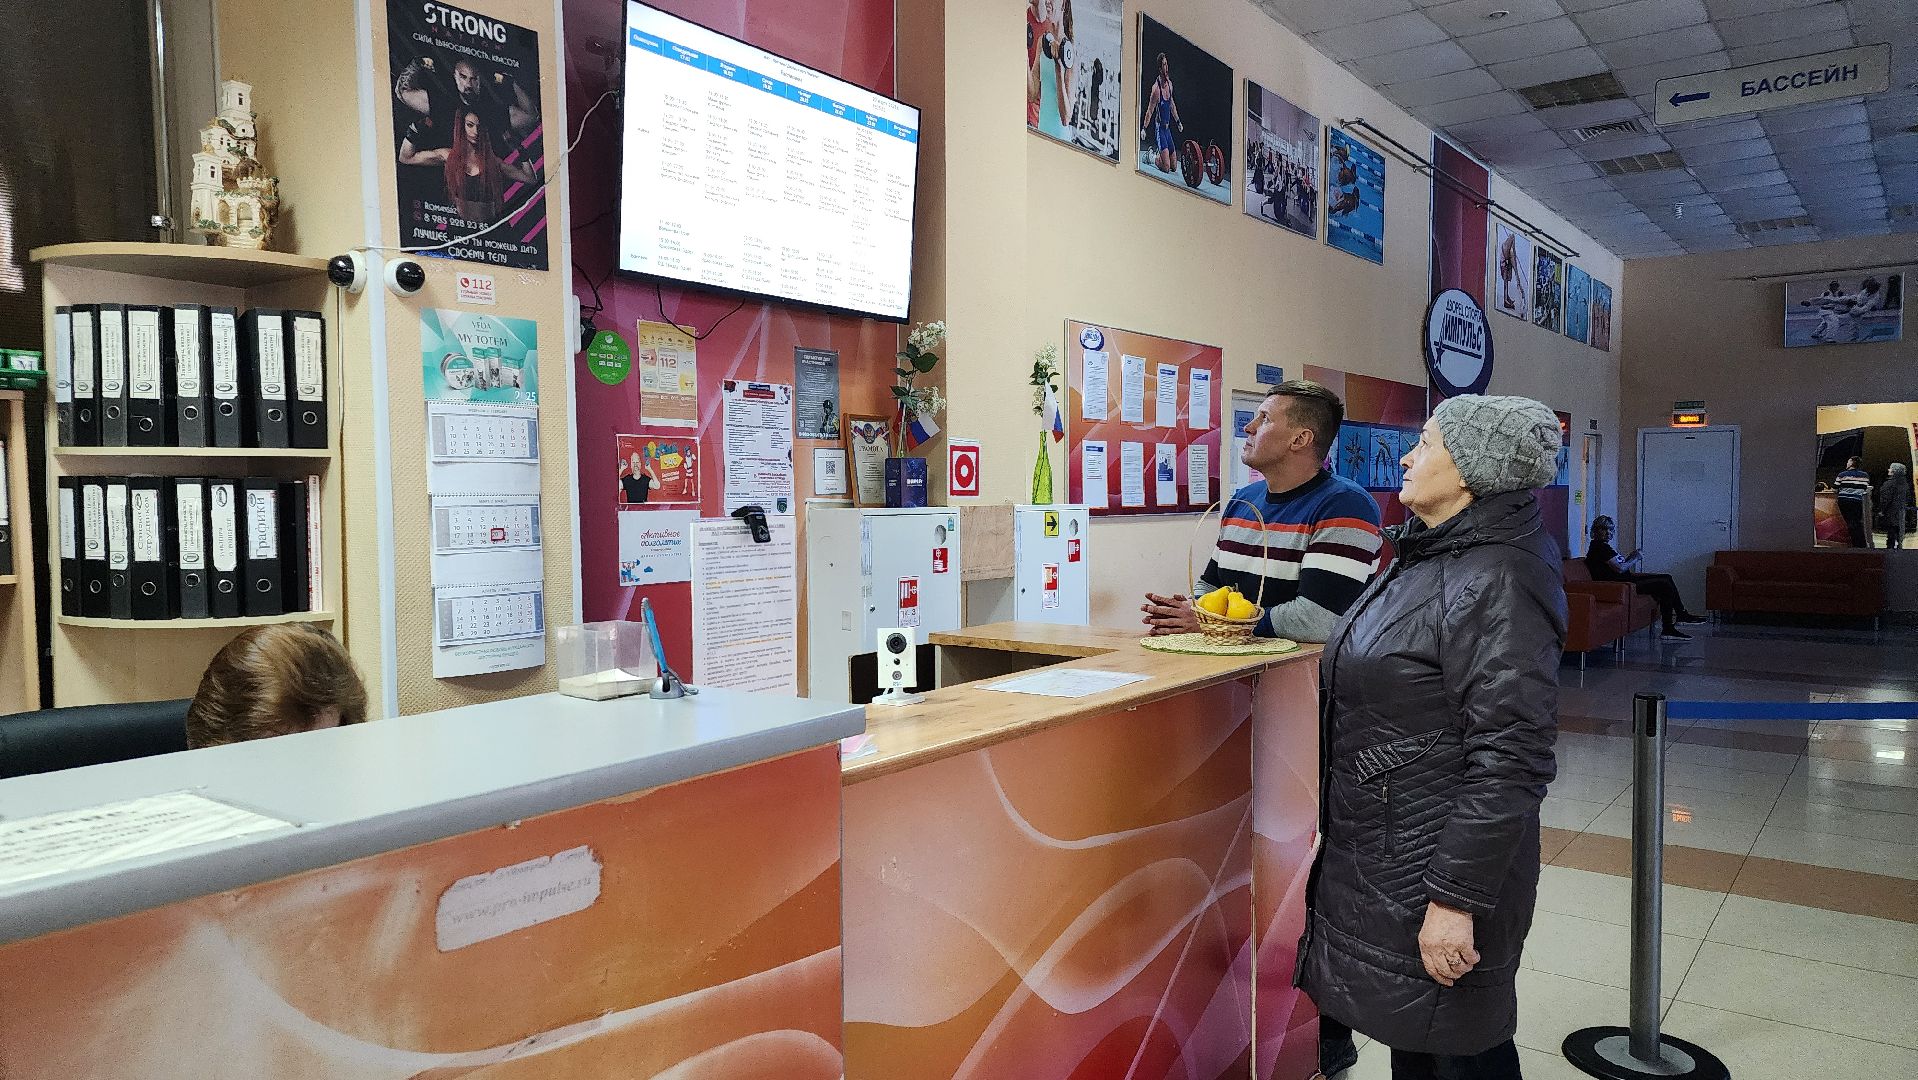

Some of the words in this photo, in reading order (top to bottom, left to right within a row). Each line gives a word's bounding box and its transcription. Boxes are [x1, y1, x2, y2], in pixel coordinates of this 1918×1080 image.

[423, 3, 507, 43] STRONG
[1741, 64, 1859, 98] БАССЕЙН
[424, 214, 430, 223] 8
[432, 214, 448, 224] 985
[412, 227, 450, 242] ЛУЧШЕЕ,
[472, 237, 482, 246] ТЫ
[485, 240, 518, 252] МОЖЕШЬ
[448, 246, 484, 261] СВОЕМУ
[488, 252, 508, 264] ТЕЛУ
[472, 279, 492, 290] 112
[1446, 299, 1464, 318] ДВОРЕЦ
[458, 334, 472, 342] MY
[475, 334, 508, 346] TOTEM
[1441, 313, 1482, 352] ИМПУЛЬС
[660, 358, 676, 368] 112
[256, 497, 271, 558] Графики
